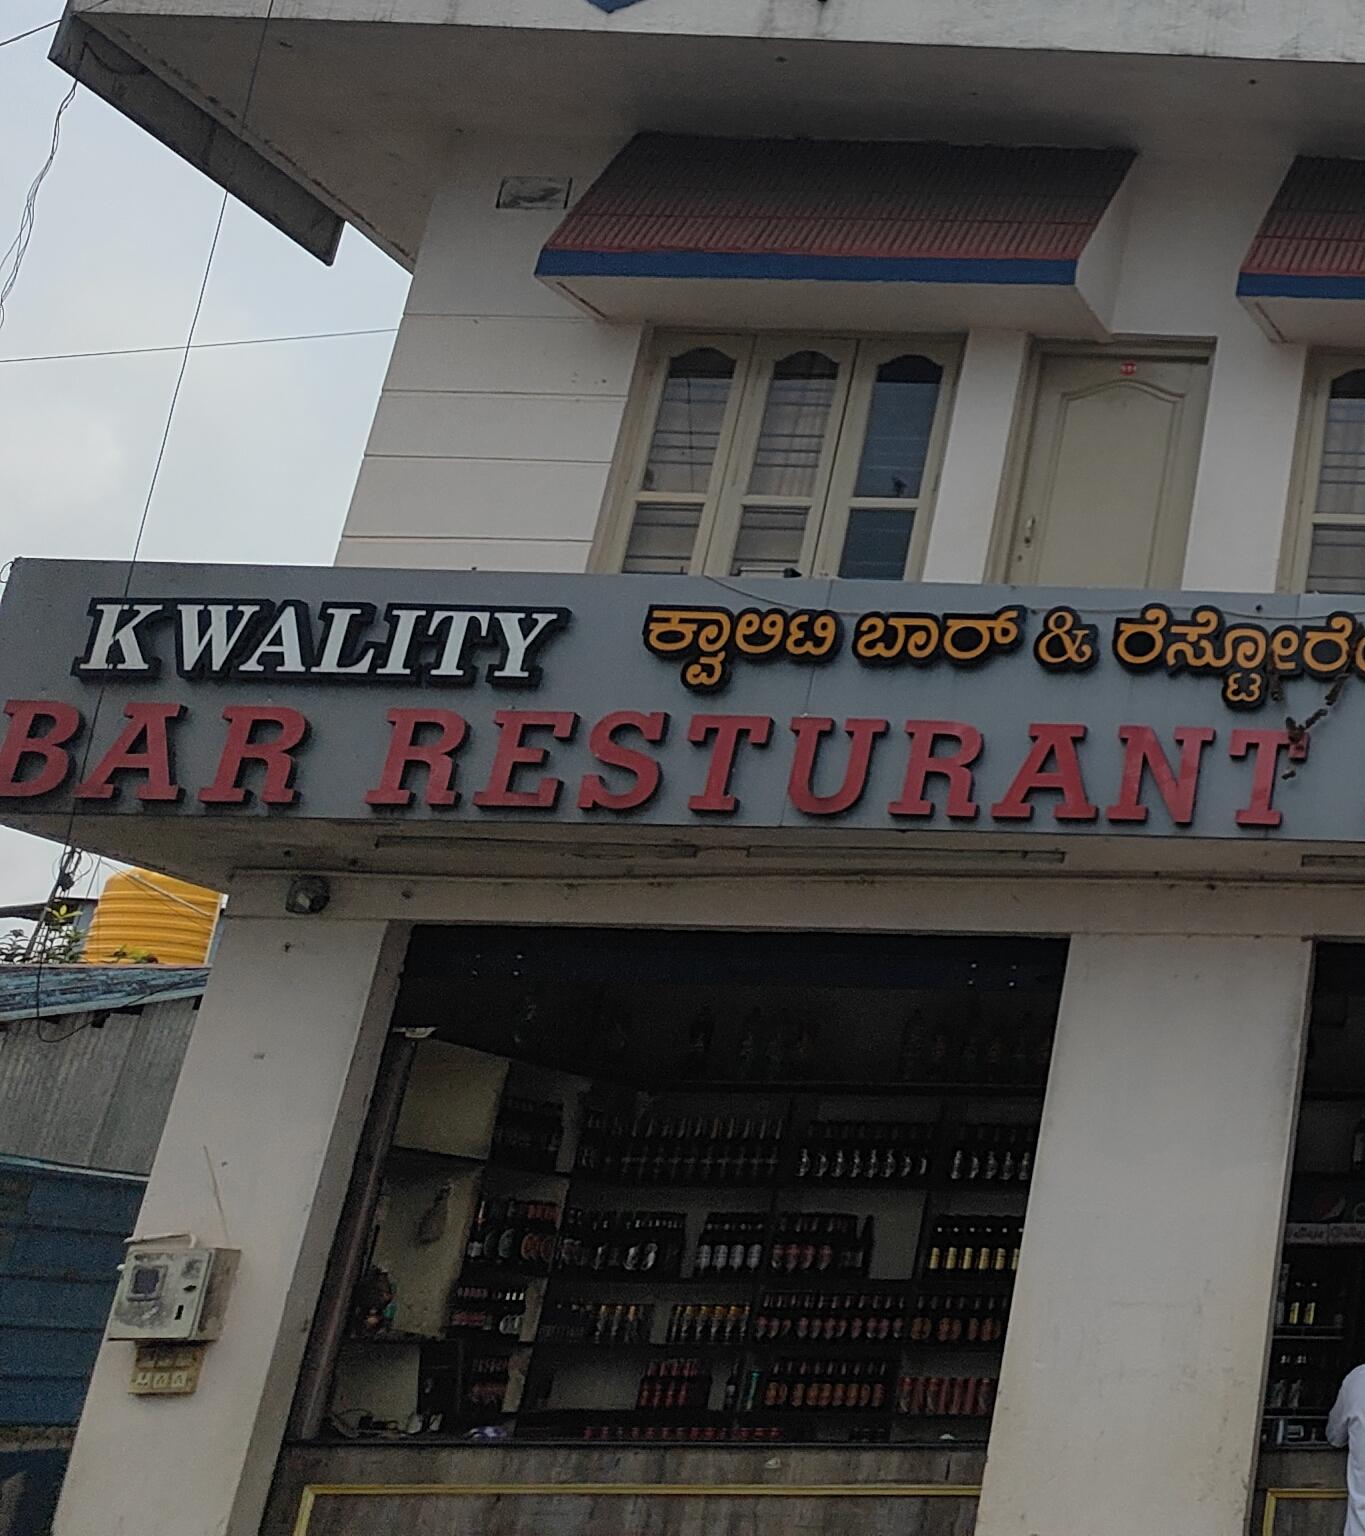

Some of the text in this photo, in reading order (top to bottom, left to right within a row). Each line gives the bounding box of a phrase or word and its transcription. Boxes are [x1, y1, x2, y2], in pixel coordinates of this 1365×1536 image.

[79, 601, 563, 680] KWALITY
[647, 608, 839, 687] ಕ್ವಾಲಿಟಿ
[856, 609, 1026, 661] ಬಾರ್
[1037, 610, 1094, 665] &
[0, 699, 309, 805] BAR
[364, 708, 1308, 827] RESTURANT
